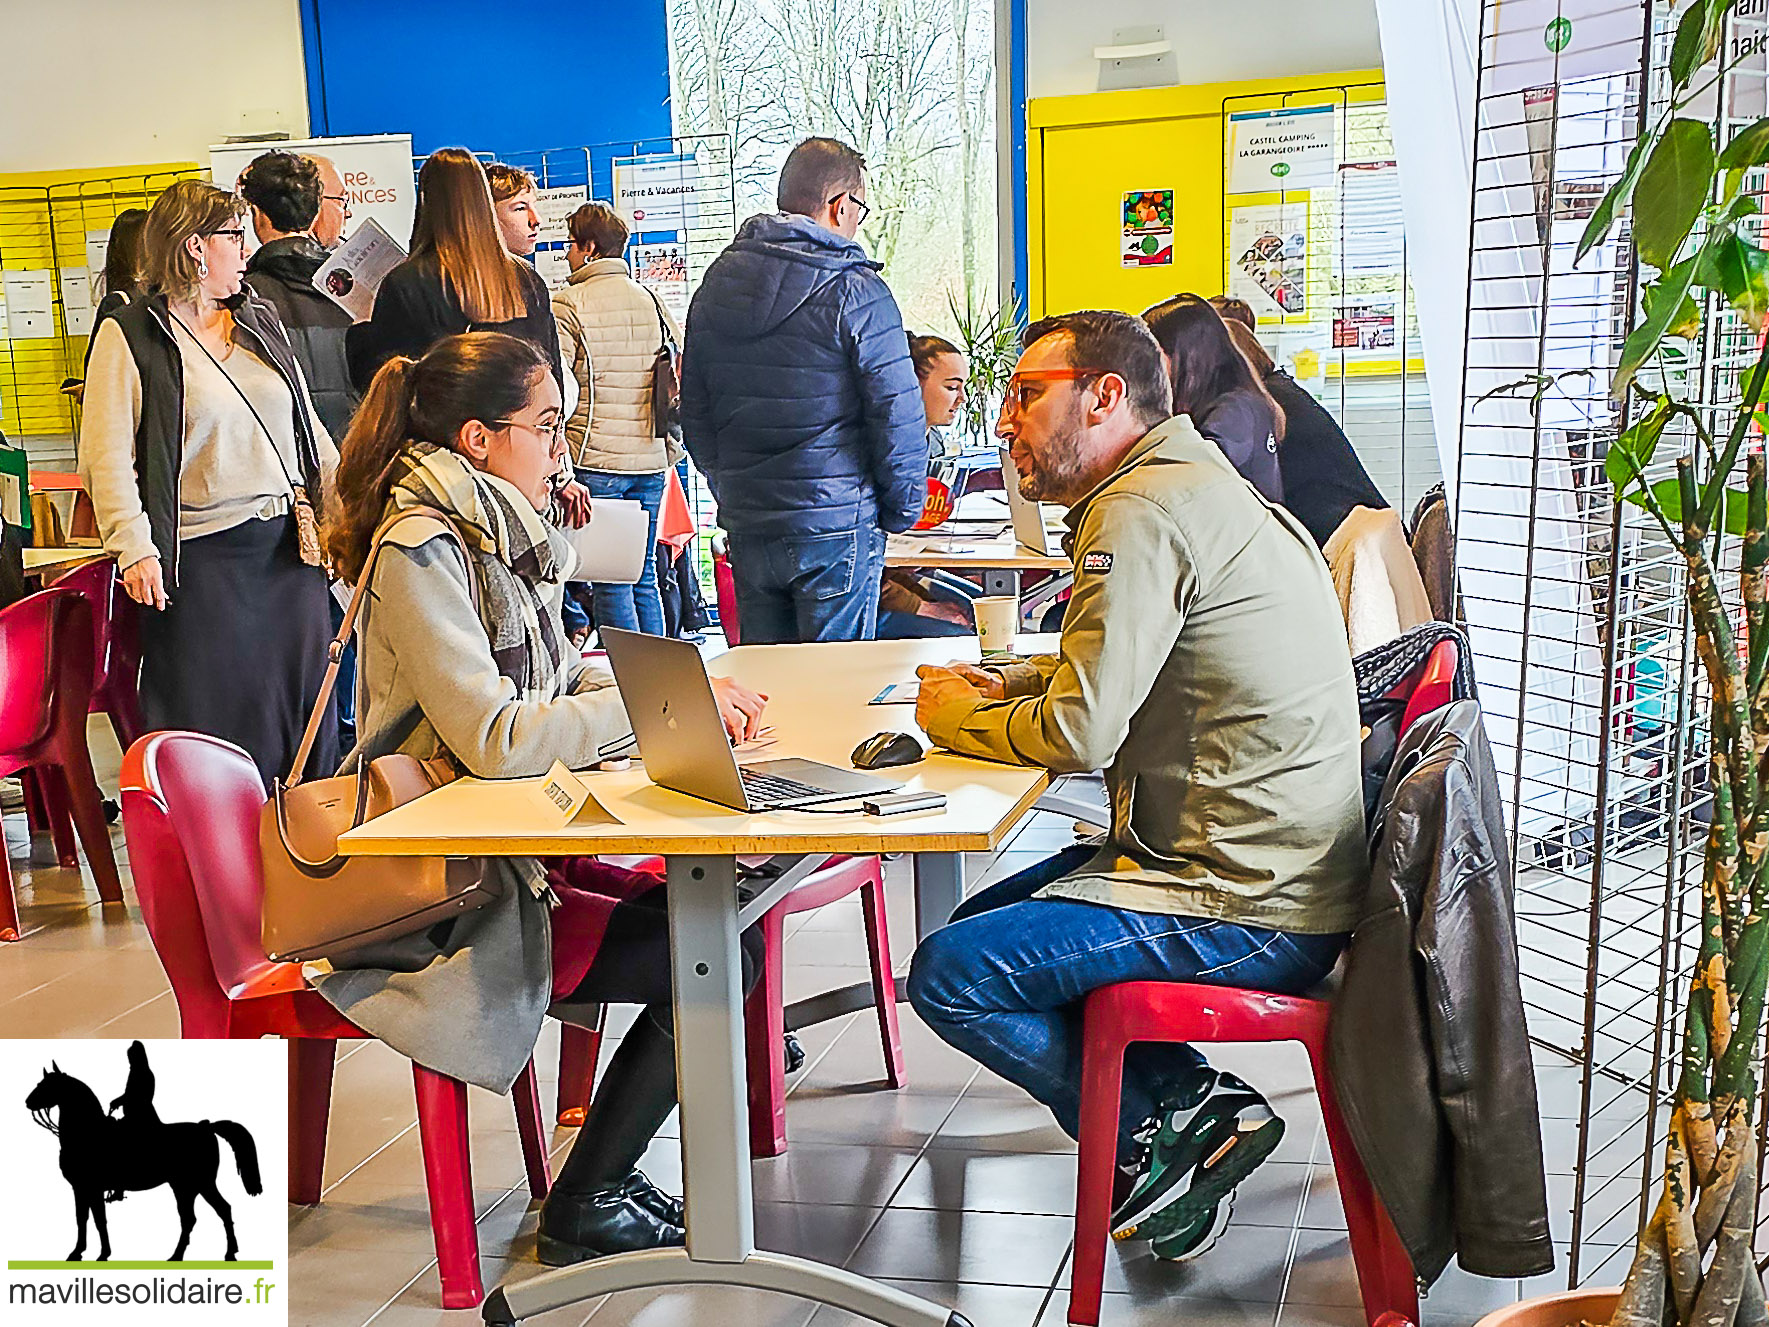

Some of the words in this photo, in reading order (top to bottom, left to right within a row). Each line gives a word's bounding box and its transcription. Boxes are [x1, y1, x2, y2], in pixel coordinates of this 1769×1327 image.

[1249, 137, 1276, 145] CASTEL
[1279, 133, 1316, 143] CAMPING
[621, 187, 646, 198] Pierre
[647, 187, 654, 196] &
[655, 184, 695, 195] Vacances
